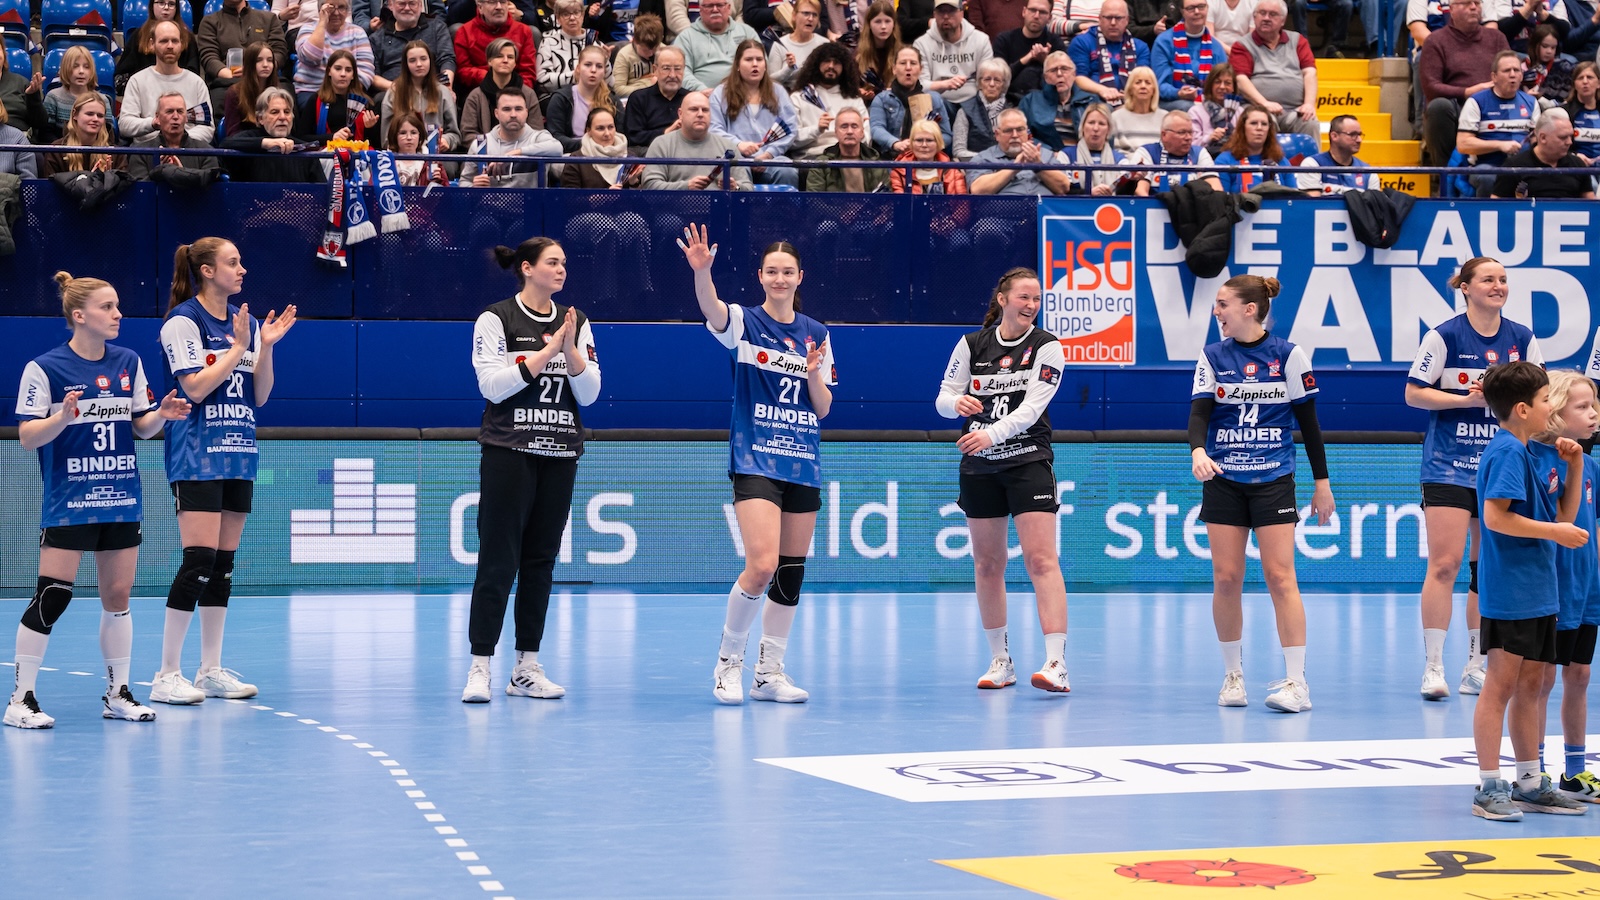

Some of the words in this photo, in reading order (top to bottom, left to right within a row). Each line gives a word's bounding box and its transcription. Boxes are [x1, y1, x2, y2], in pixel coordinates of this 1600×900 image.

[1317, 92, 1363, 108] pische
[1146, 208, 1282, 264] DE
[1045, 241, 1133, 291] HSG
[1045, 293, 1133, 315] Blomberg
[1045, 313, 1092, 336] Lippe
[1063, 341, 1132, 361] andball
[770, 355, 808, 374] Lippis
[1419, 352, 1433, 374] DMV
[25, 384, 37, 407] DMV
[539, 376, 564, 403] 27
[778, 376, 801, 404] 21
[1227, 387, 1286, 402] Lippische
[83, 403, 130, 419] Lippisch
[513, 408, 575, 426] BINDER
[754, 403, 818, 427] BINDER
[990, 395, 1009, 420] 16
[1237, 404, 1260, 427] 14
[93, 422, 116, 451] 31
[1215, 427, 1282, 442] BINDER
[1456, 422, 1500, 438] BIND
[67, 455, 136, 473] BINDER
[935, 480, 1076, 559] af
[1104, 491, 1429, 560] steern
